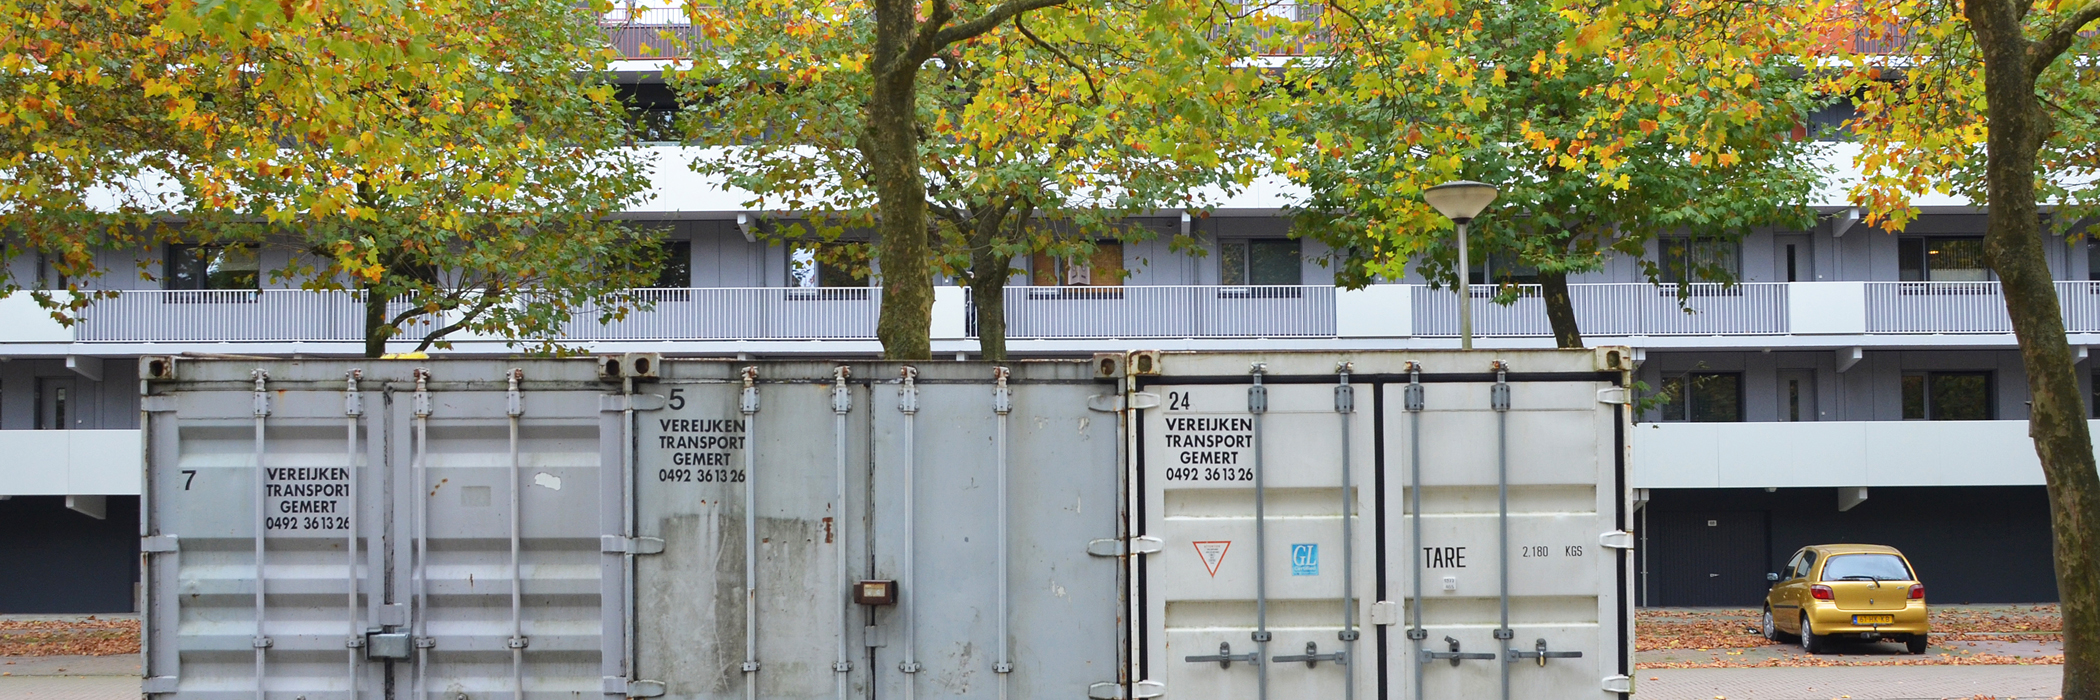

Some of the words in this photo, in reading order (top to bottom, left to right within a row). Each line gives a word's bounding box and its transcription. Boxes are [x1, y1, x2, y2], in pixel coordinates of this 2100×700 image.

[668, 388, 685, 410] 5
[1169, 391, 1190, 411] 24
[659, 419, 745, 432] VEREIJKEN
[1165, 418, 1252, 431] VEREIJKEN
[659, 436, 745, 449] TRANSPORT
[1165, 435, 1252, 448] TRANSPORT
[673, 452, 731, 466] GEMERT
[1180, 451, 1238, 464] GEMERT
[181, 469, 197, 491] 7
[266, 468, 349, 481] VEREIJKEN
[659, 468, 691, 482] 0492
[1166, 467, 1199, 481] 0492
[266, 484, 349, 497] TRANSPORT
[280, 501, 337, 513] GEMERT
[266, 517, 298, 530] 0492
[1293, 545, 1317, 566] GL
[1423, 547, 1466, 569] TARE
[1522, 546, 1549, 558] 2.180
[1565, 545, 1583, 557] KGS
